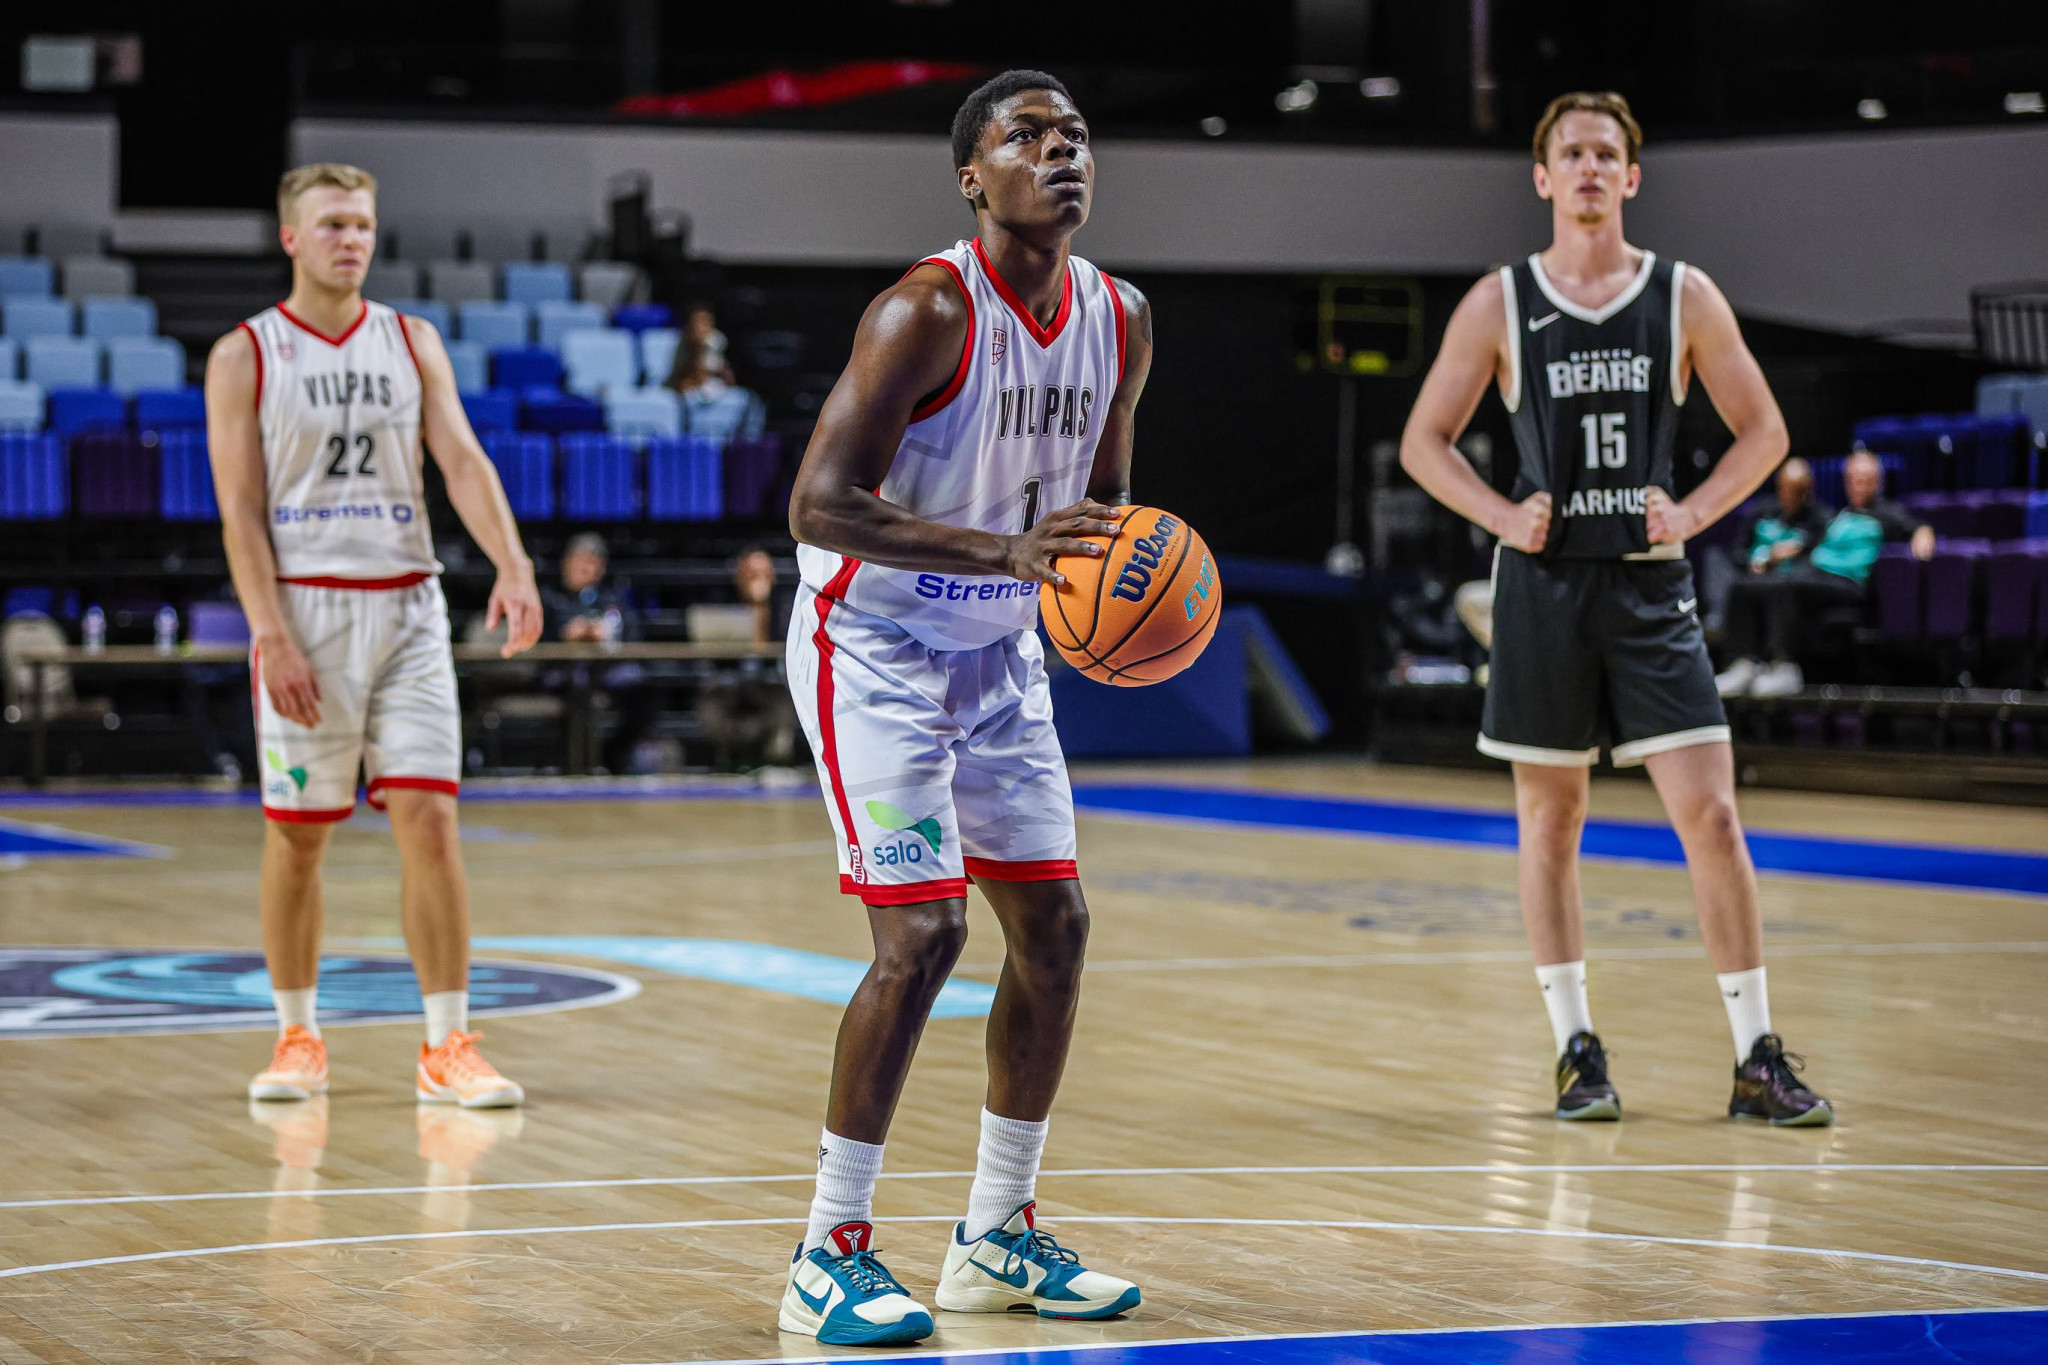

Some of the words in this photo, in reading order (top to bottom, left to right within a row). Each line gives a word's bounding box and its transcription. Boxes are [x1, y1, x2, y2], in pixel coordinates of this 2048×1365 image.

[303, 371, 392, 407] VILPAS
[1546, 355, 1652, 398] BEARS
[998, 384, 1094, 440] VILPAS
[327, 434, 377, 477] 22
[1580, 412, 1628, 469] 15
[275, 504, 384, 525] Stremet
[1020, 476, 1044, 535] 1
[1562, 488, 1646, 518] ARHUS
[1110, 514, 1181, 602] Wilson
[873, 840, 922, 866] salo
